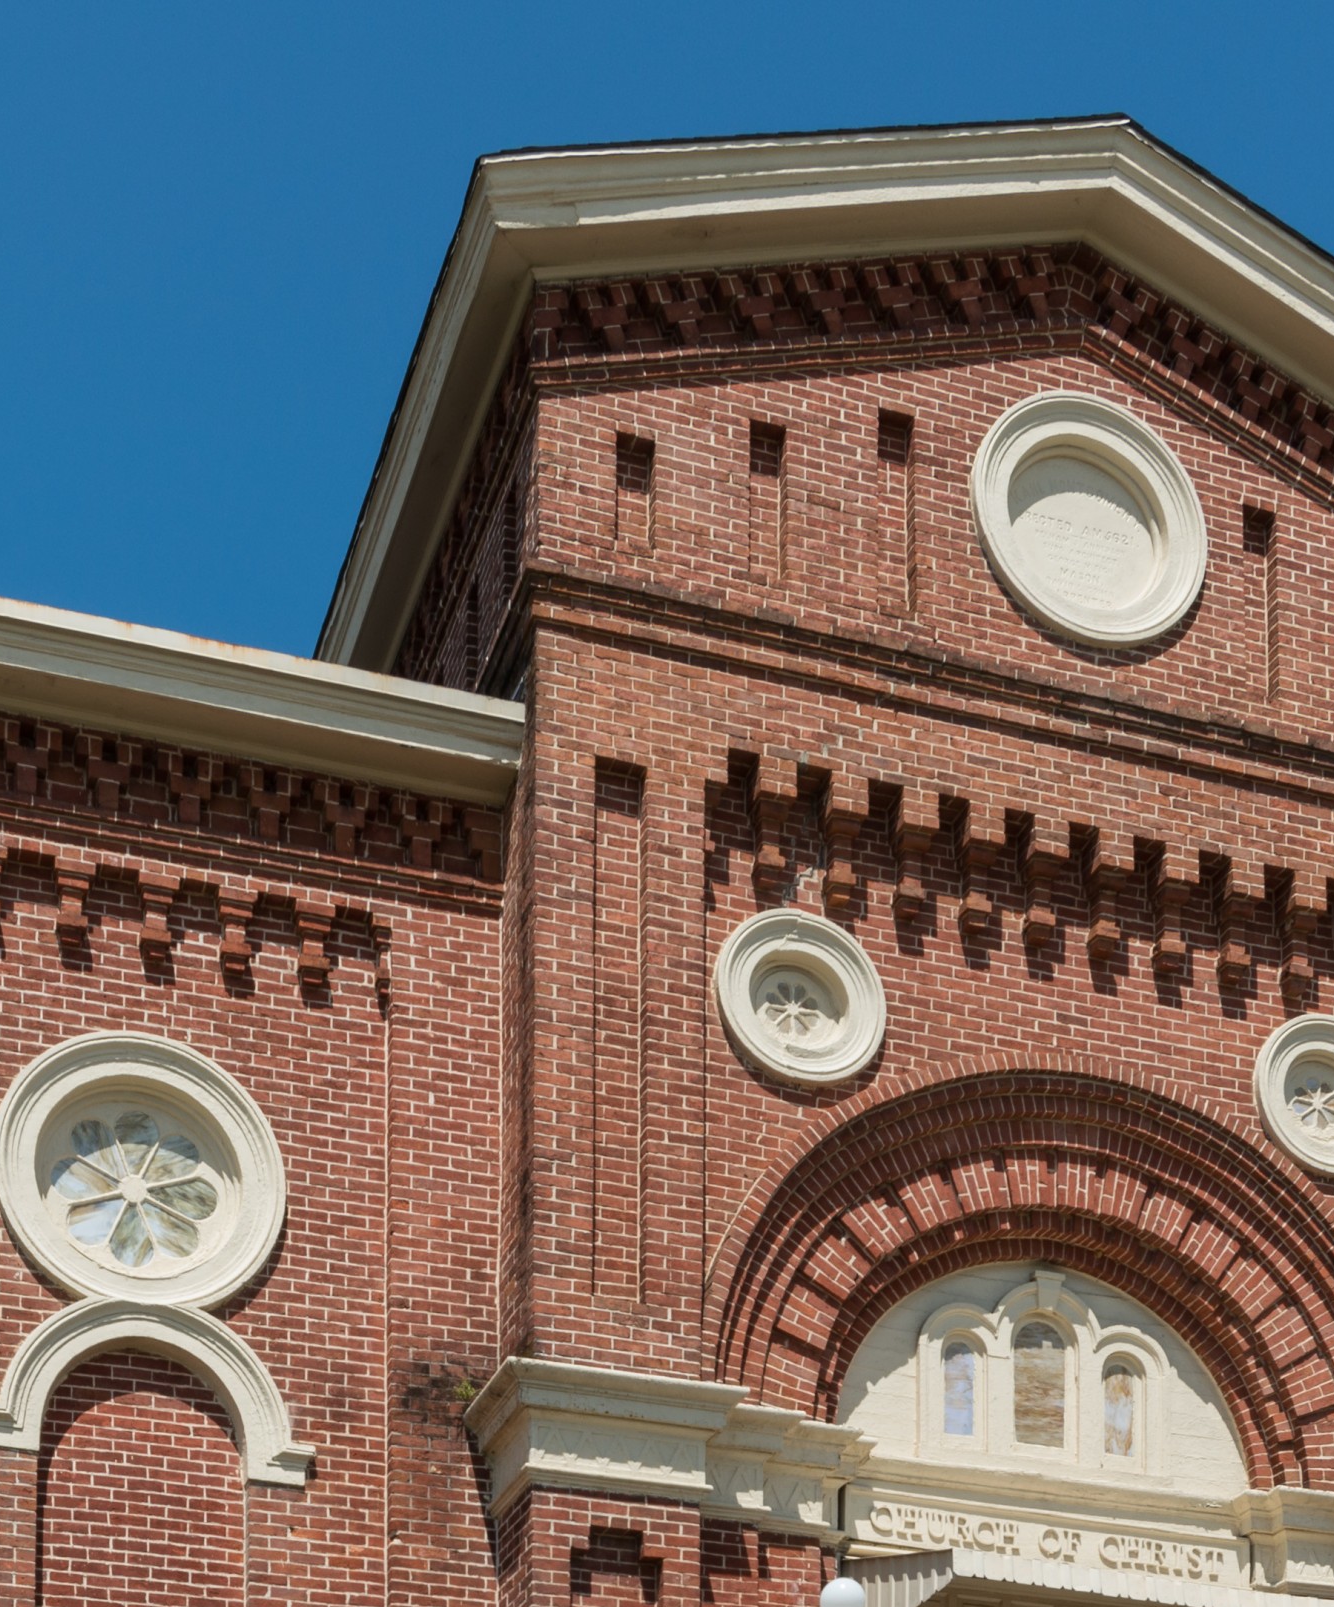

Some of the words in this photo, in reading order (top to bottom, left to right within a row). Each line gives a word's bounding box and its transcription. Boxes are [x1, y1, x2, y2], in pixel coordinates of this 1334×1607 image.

[869, 1505, 1021, 1556] CHURCH
[1037, 1527, 1082, 1563] OF
[1097, 1535, 1225, 1583] CHRIST
